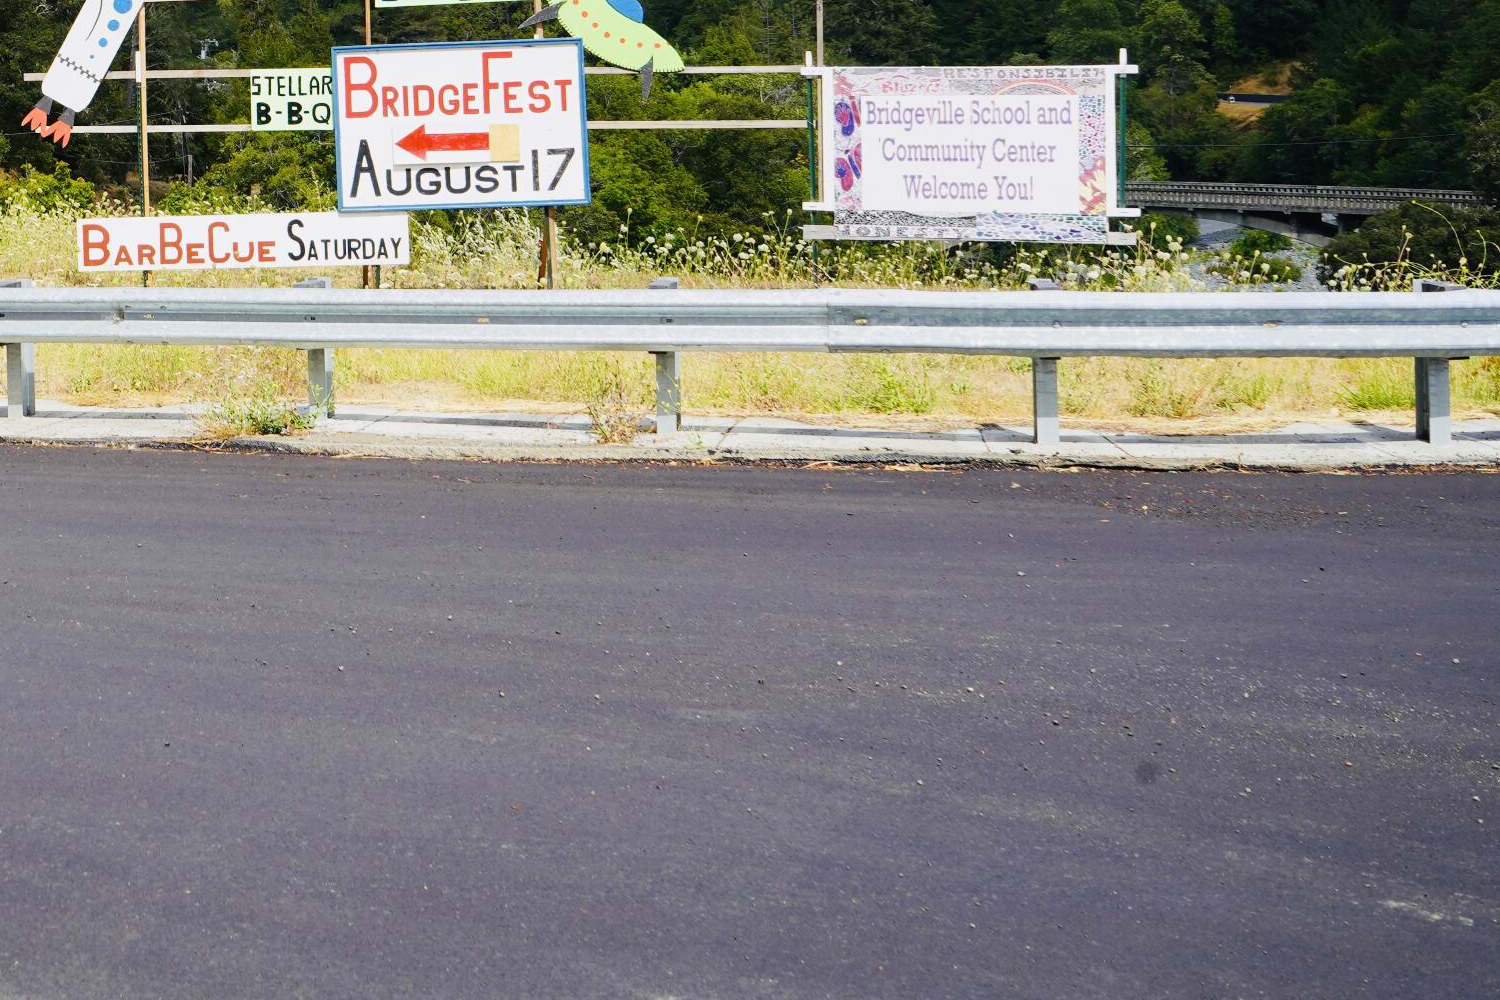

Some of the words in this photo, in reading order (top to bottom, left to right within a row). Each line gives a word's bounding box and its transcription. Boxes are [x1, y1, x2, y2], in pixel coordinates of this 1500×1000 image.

[251, 75, 333, 97] STELLAR
[256, 102, 332, 125] B-B-Q
[865, 100, 965, 131] Bridgeville
[970, 100, 1032, 125] School
[1036, 100, 1073, 125] and
[881, 137, 987, 169] Community
[992, 137, 1057, 163] Center
[531, 147, 576, 192] 17
[902, 174, 988, 200] Welcome
[993, 175, 1035, 201] You!
